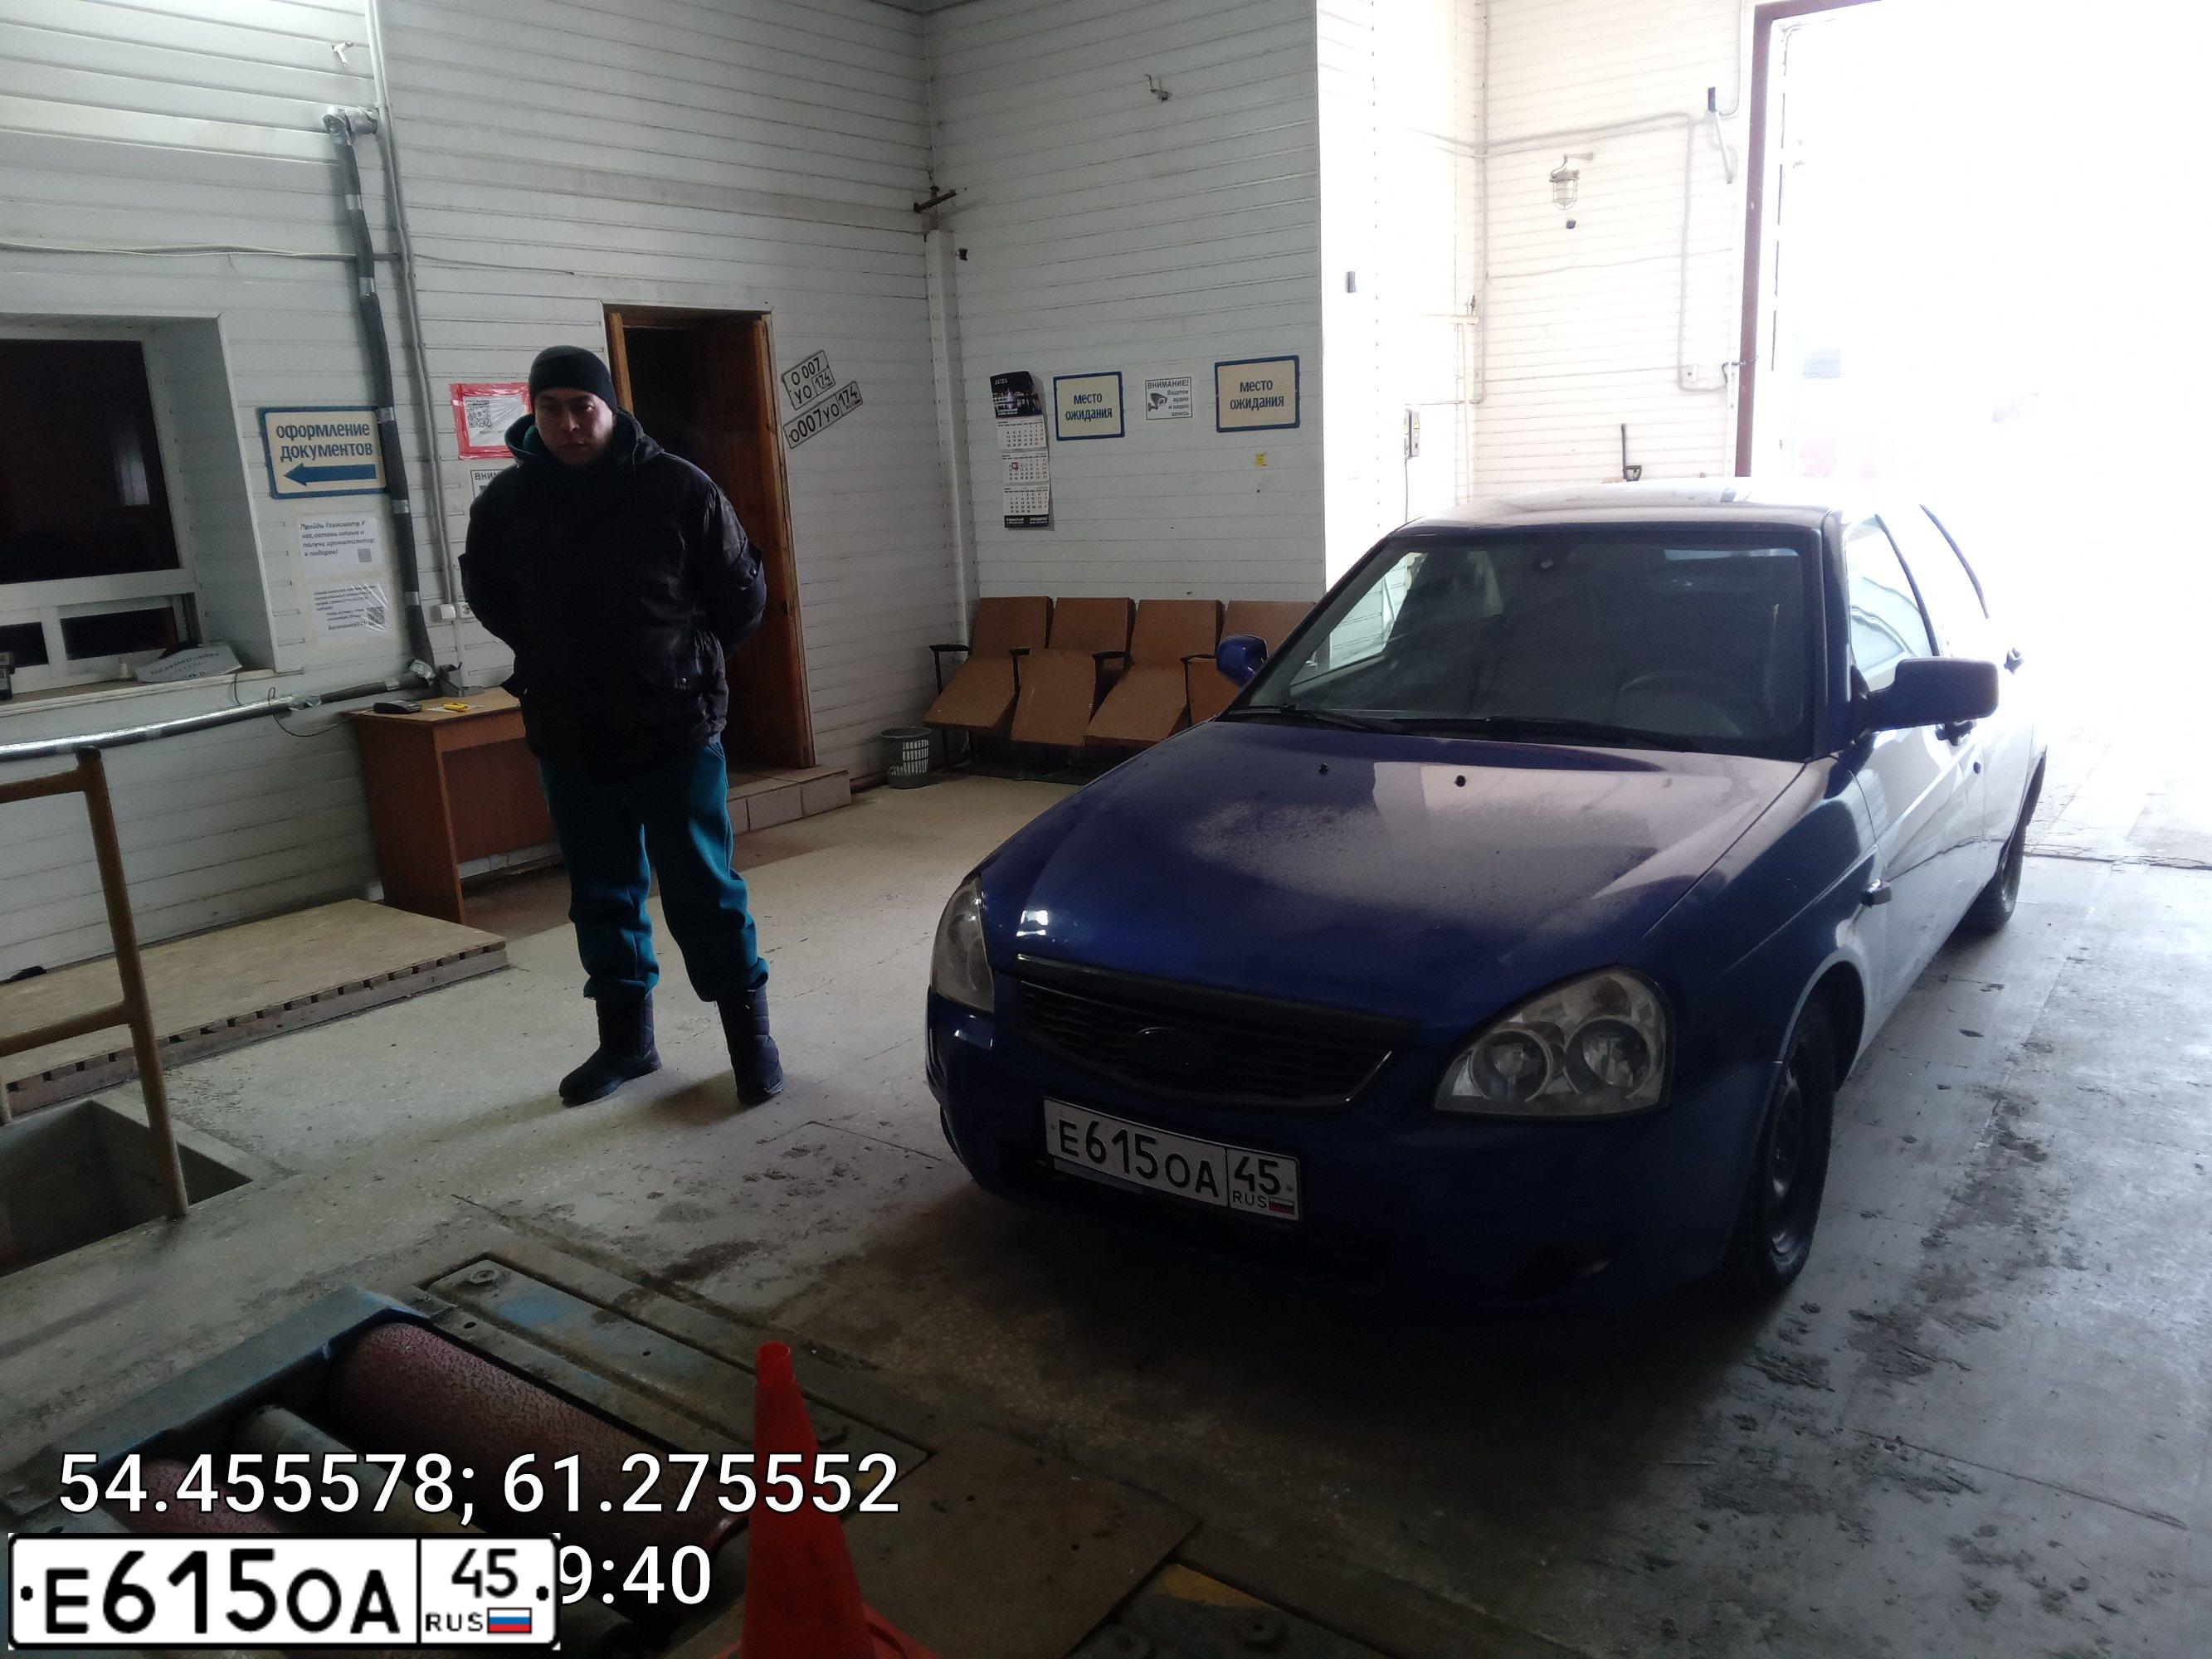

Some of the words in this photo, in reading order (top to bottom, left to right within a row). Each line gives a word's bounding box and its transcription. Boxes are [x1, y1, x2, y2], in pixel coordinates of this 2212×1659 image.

[801, 357, 821, 379] 007
[815, 372, 831, 387] 174
[1147, 378, 1190, 389] ВНИМАНИЕ!
[1239, 380, 1274, 392] место
[838, 386, 858, 406] 174
[1073, 393, 1103, 405] место
[1230, 396, 1284, 411] ожидания
[1065, 407, 1113, 422] ожидания
[275, 423, 371, 441] оформление
[280, 442, 373, 462] документов
[1234, 1155, 1280, 1195] 45
[1232, 1190, 1267, 1209] RUS
